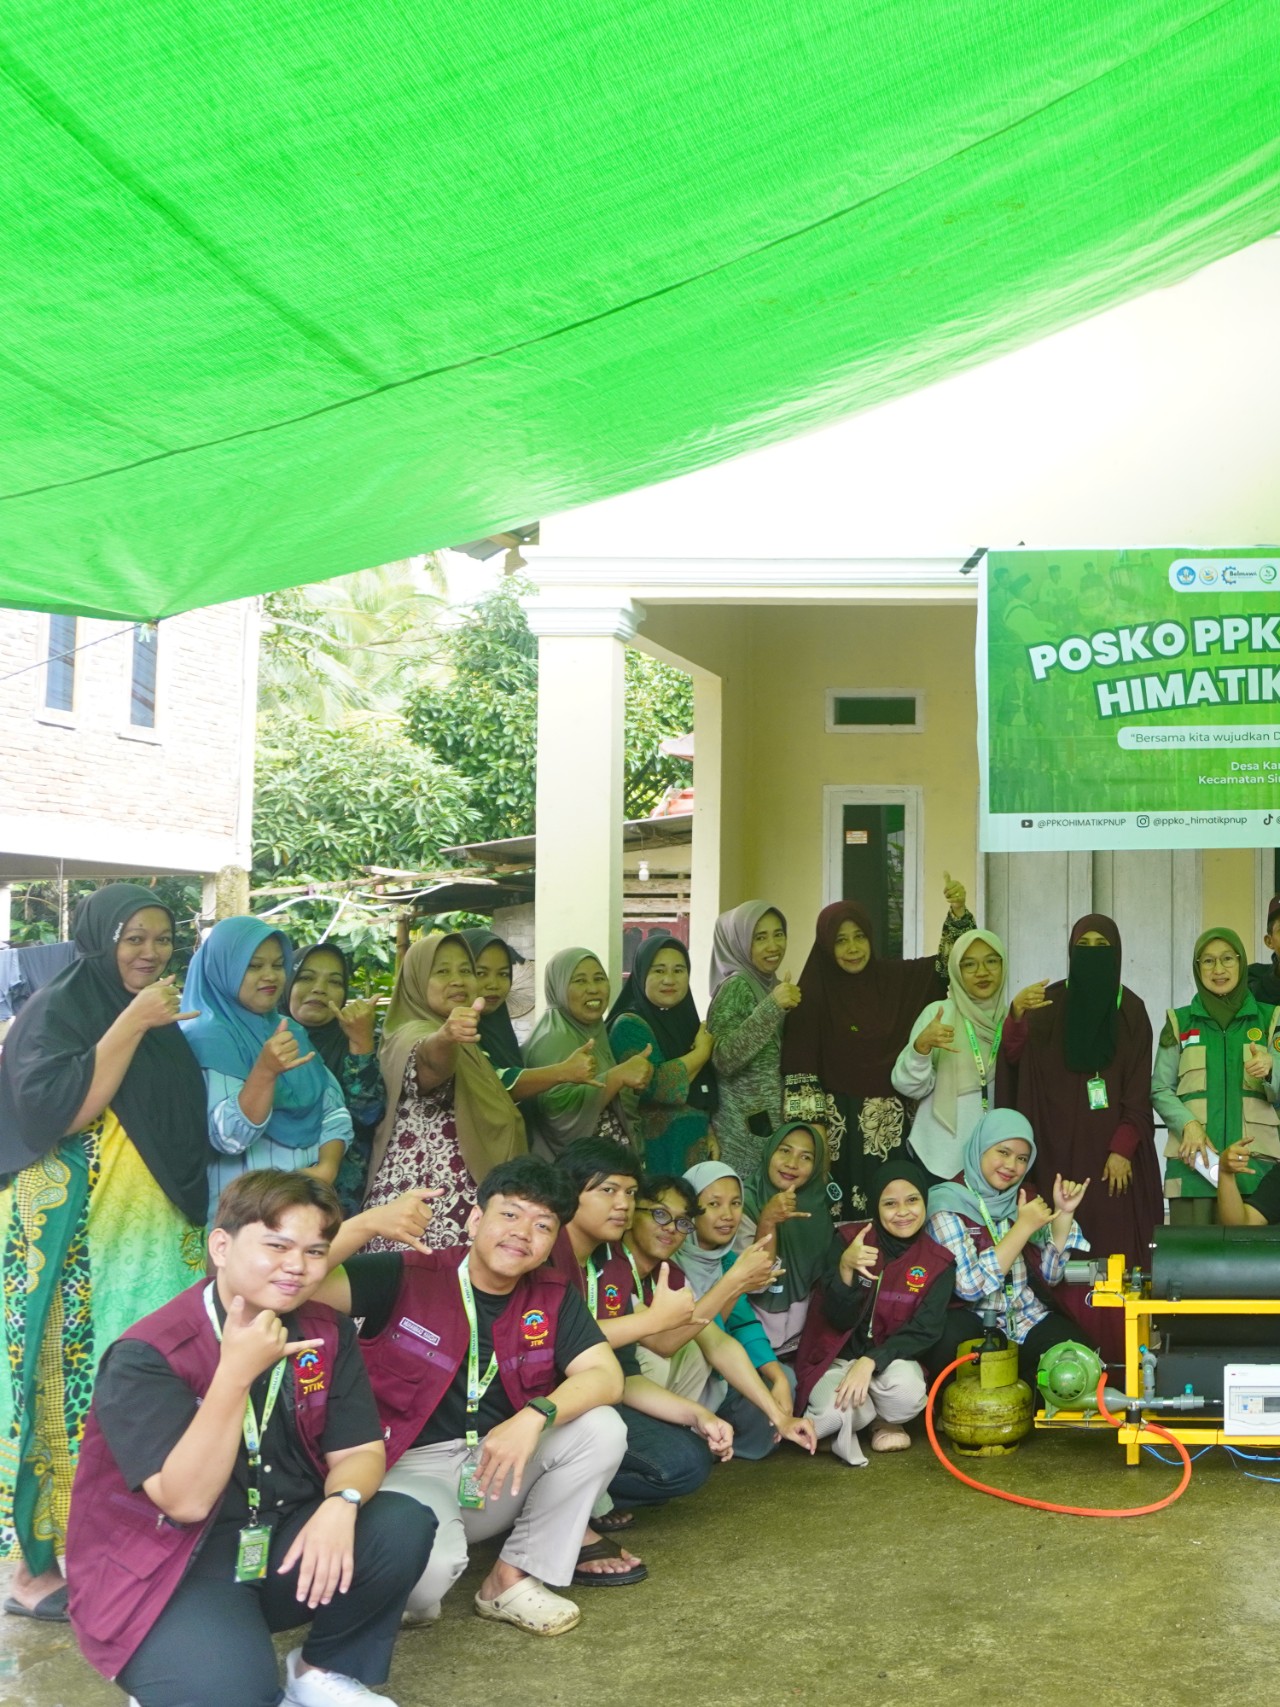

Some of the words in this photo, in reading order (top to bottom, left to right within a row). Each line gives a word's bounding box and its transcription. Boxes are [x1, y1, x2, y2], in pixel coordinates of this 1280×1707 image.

[1028, 622, 1186, 680] POSKO
[1189, 732, 1210, 742] kita
[1213, 731, 1270, 744] wujudkan
[1231, 761, 1259, 771] Desa
[1198, 774, 1264, 784] Kecamatan
[1037, 818, 1126, 828] @PPKOHIMATIKPNUP
[1153, 816, 1247, 826] @ppko_himatikpnup
[304, 1381, 325, 1395] JTIK
